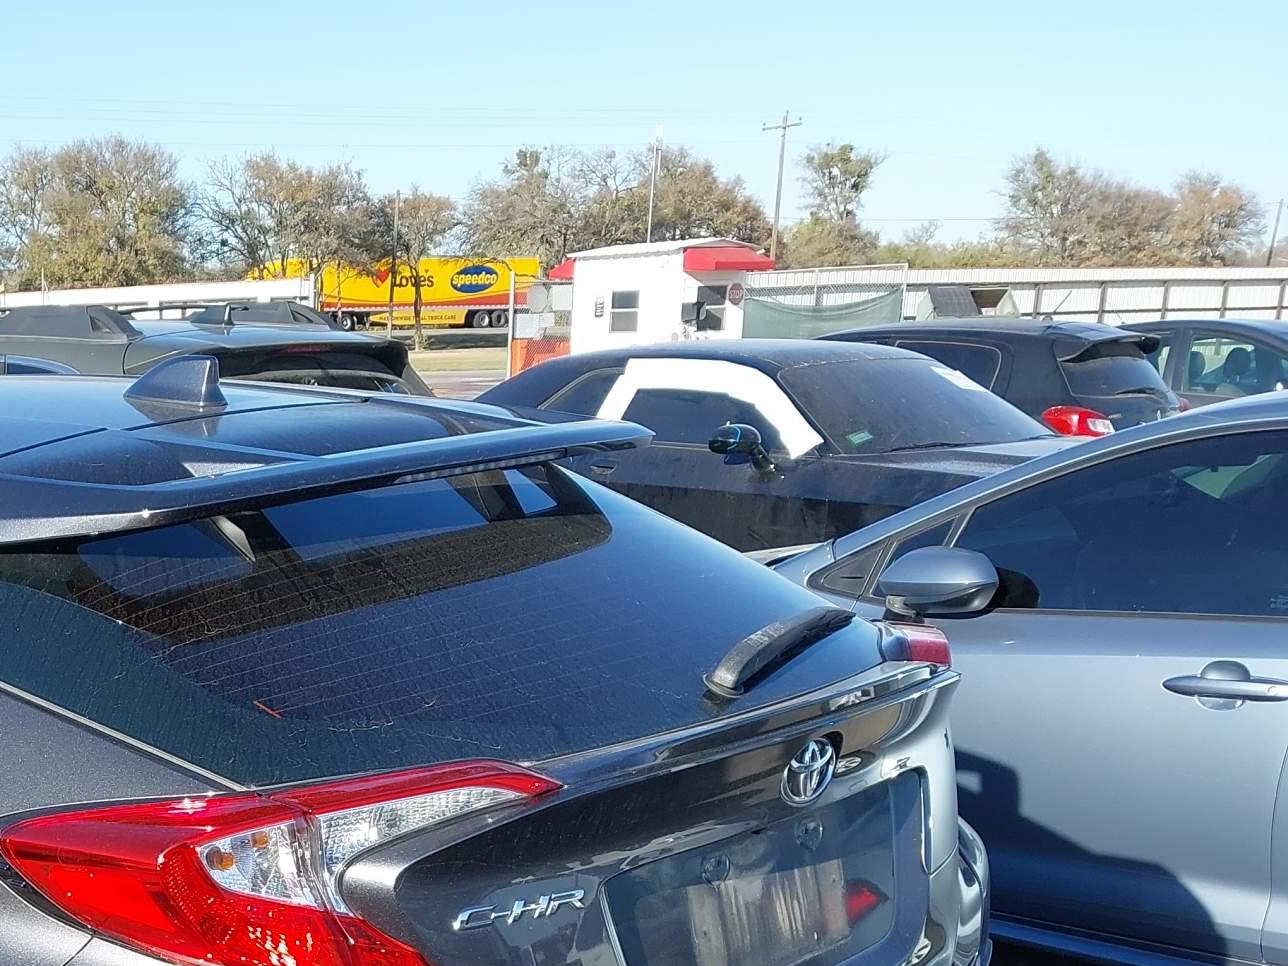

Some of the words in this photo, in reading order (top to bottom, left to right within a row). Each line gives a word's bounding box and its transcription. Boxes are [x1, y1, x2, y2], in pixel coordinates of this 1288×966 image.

[452, 271, 497, 288] speedco
[730, 289, 744, 299] STOP
[452, 889, 585, 930] C-HR
